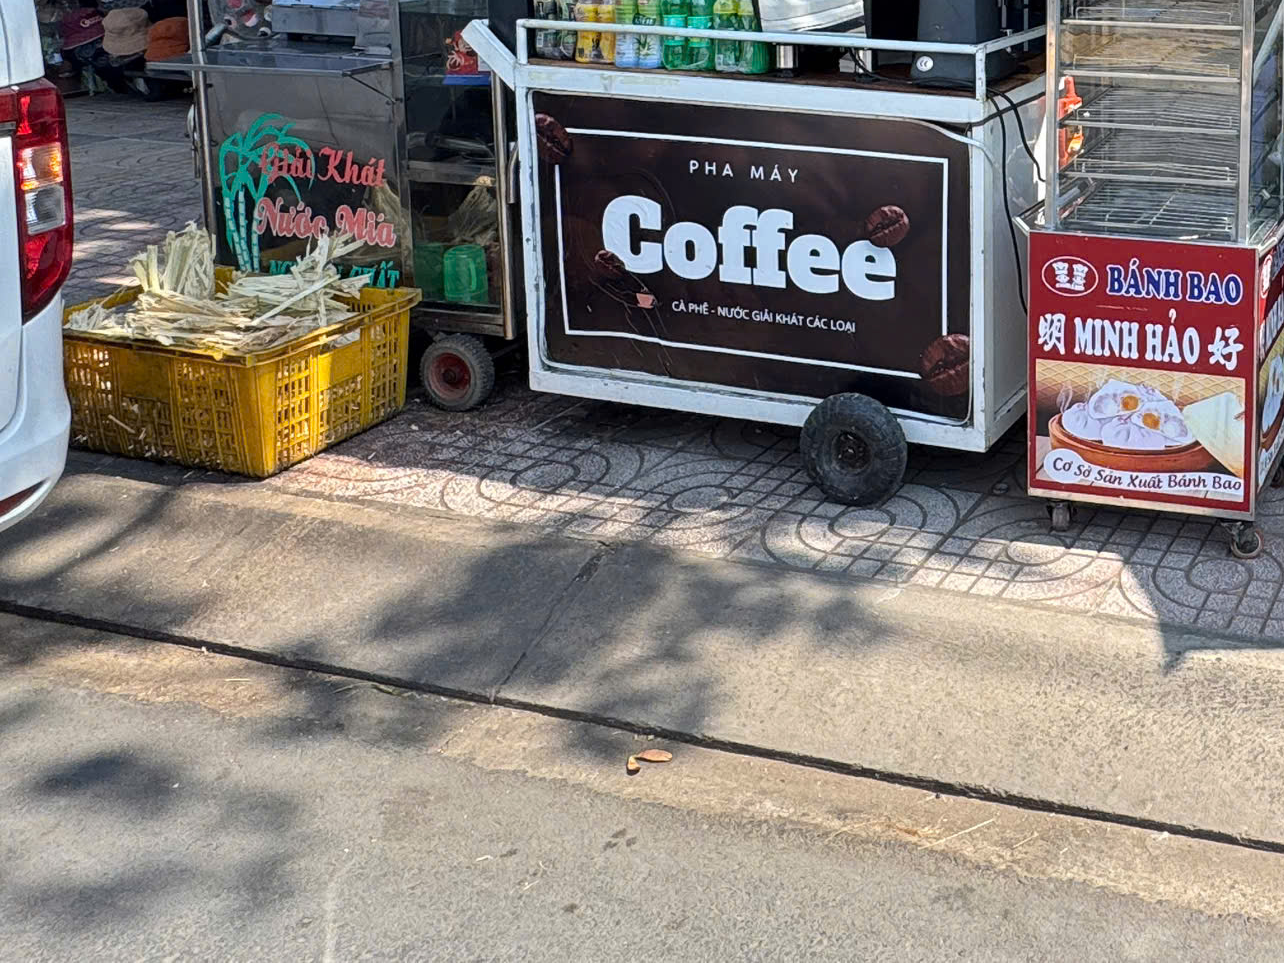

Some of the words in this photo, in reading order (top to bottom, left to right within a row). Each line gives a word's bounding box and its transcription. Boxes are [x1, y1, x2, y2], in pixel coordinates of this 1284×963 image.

[317, 146, 386, 187] Khát
[689, 159, 734, 178] PHA
[750, 163, 800, 183] MÁY
[255, 197, 330, 239] Nước
[335, 204, 397, 248] Mía
[601, 195, 897, 301] Coffee
[1106, 258, 1183, 301] BÁNH
[1186, 270, 1243, 305] BAO
[672, 299, 687, 313] CÀ
[689, 301, 709, 315] PHÊ
[717, 304, 750, 320] NƯỚC
[752, 308, 773, 323] GIẢI
[775, 311, 804, 326] KHÁT
[806, 314, 828, 330] CÁC
[830, 320, 856, 334] LOẠI
[1073, 316, 1140, 360] MINH
[1144, 308, 1200, 366] HẢO
[1207, 326, 1244, 372] 好
[1052, 456, 1073, 472] Cơ
[1074, 459, 1092, 479] Sở
[1094, 467, 1123, 487] Sản
[1126, 474, 1163, 490] Xuất
[1167, 474, 1206, 489] Bánh
[1211, 476, 1242, 491] Bao
